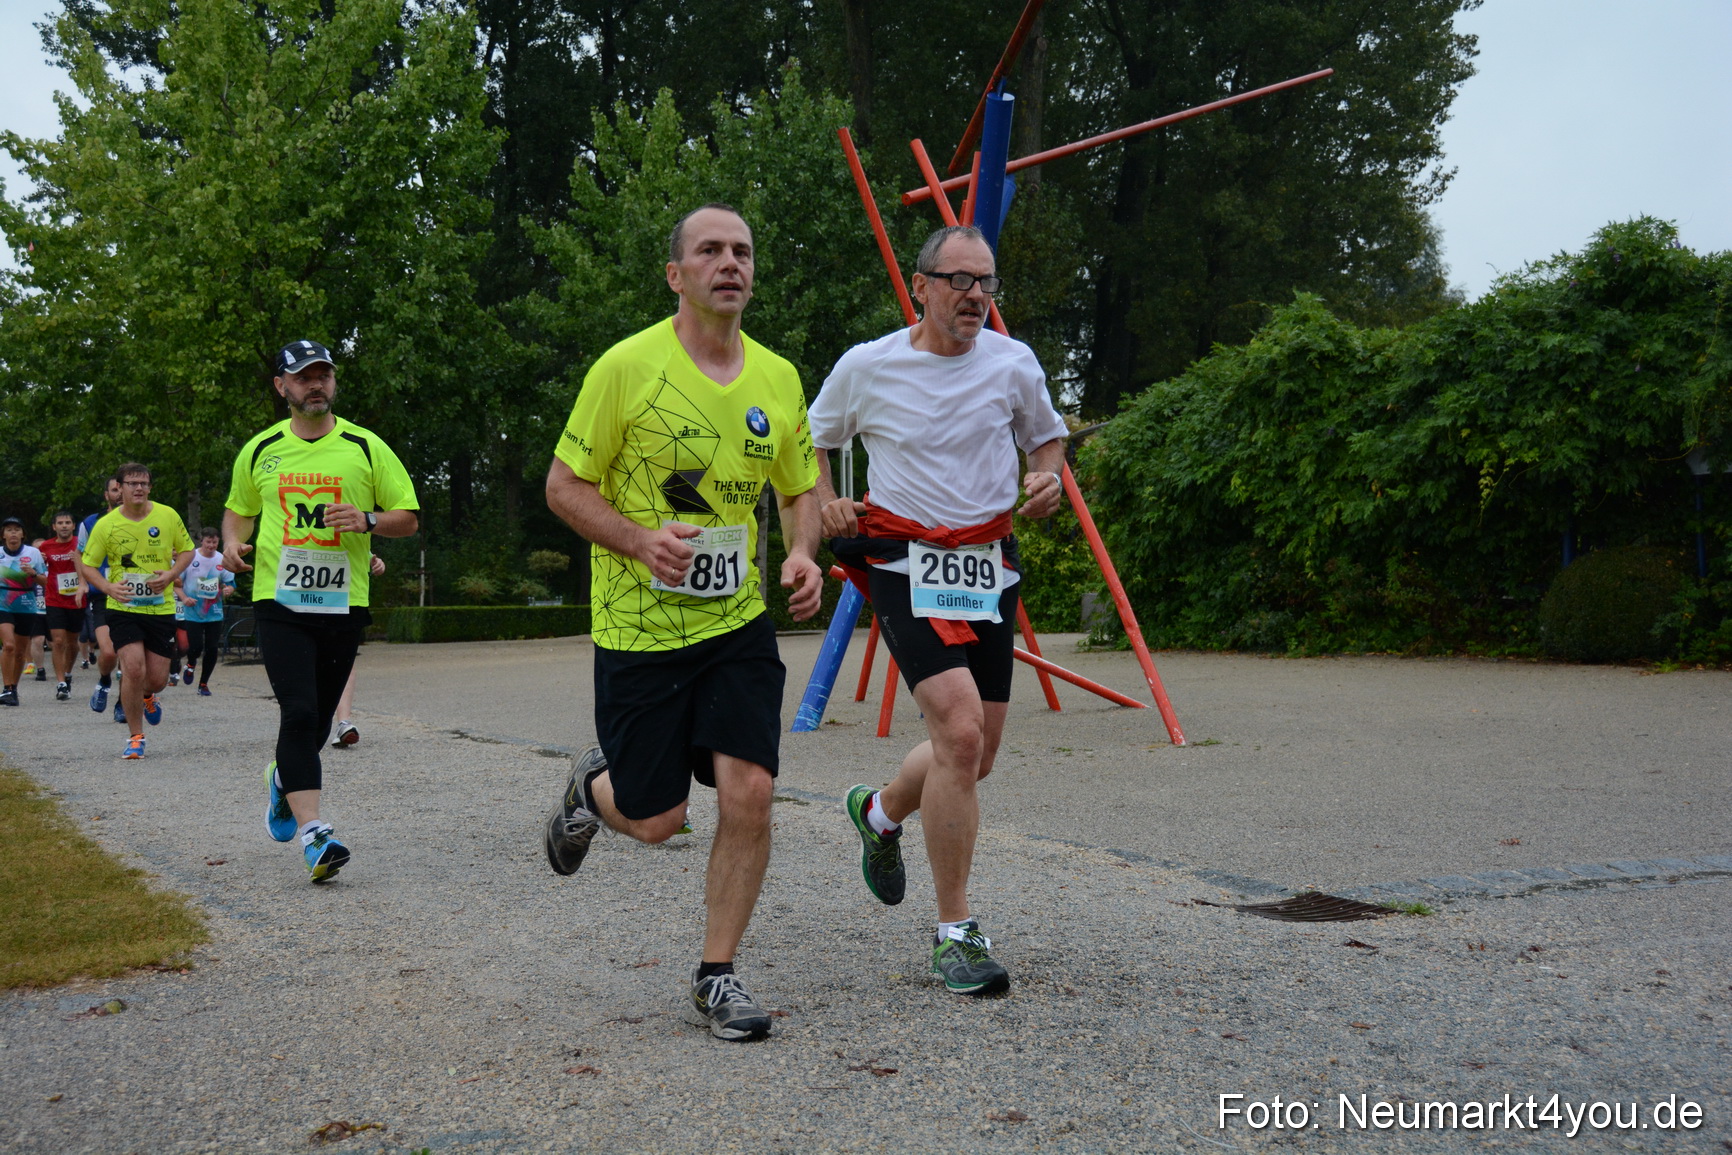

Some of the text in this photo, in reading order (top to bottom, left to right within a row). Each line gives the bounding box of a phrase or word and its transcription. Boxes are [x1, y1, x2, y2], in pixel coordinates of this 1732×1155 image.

[745, 439, 774, 455] Partl
[744, 451, 773, 461] Neumarkt
[278, 472, 343, 486] Müller
[714, 480, 757, 494] THE NEXT
[723, 493, 739, 504] 100
[295, 503, 326, 529] M
[284, 563, 345, 589] 2804
[680, 551, 740, 591] 891
[921, 553, 996, 590] 2699
[127, 582, 160, 596] 288
[300, 593, 324, 604] Mike
[936, 594, 984, 609] Günther
